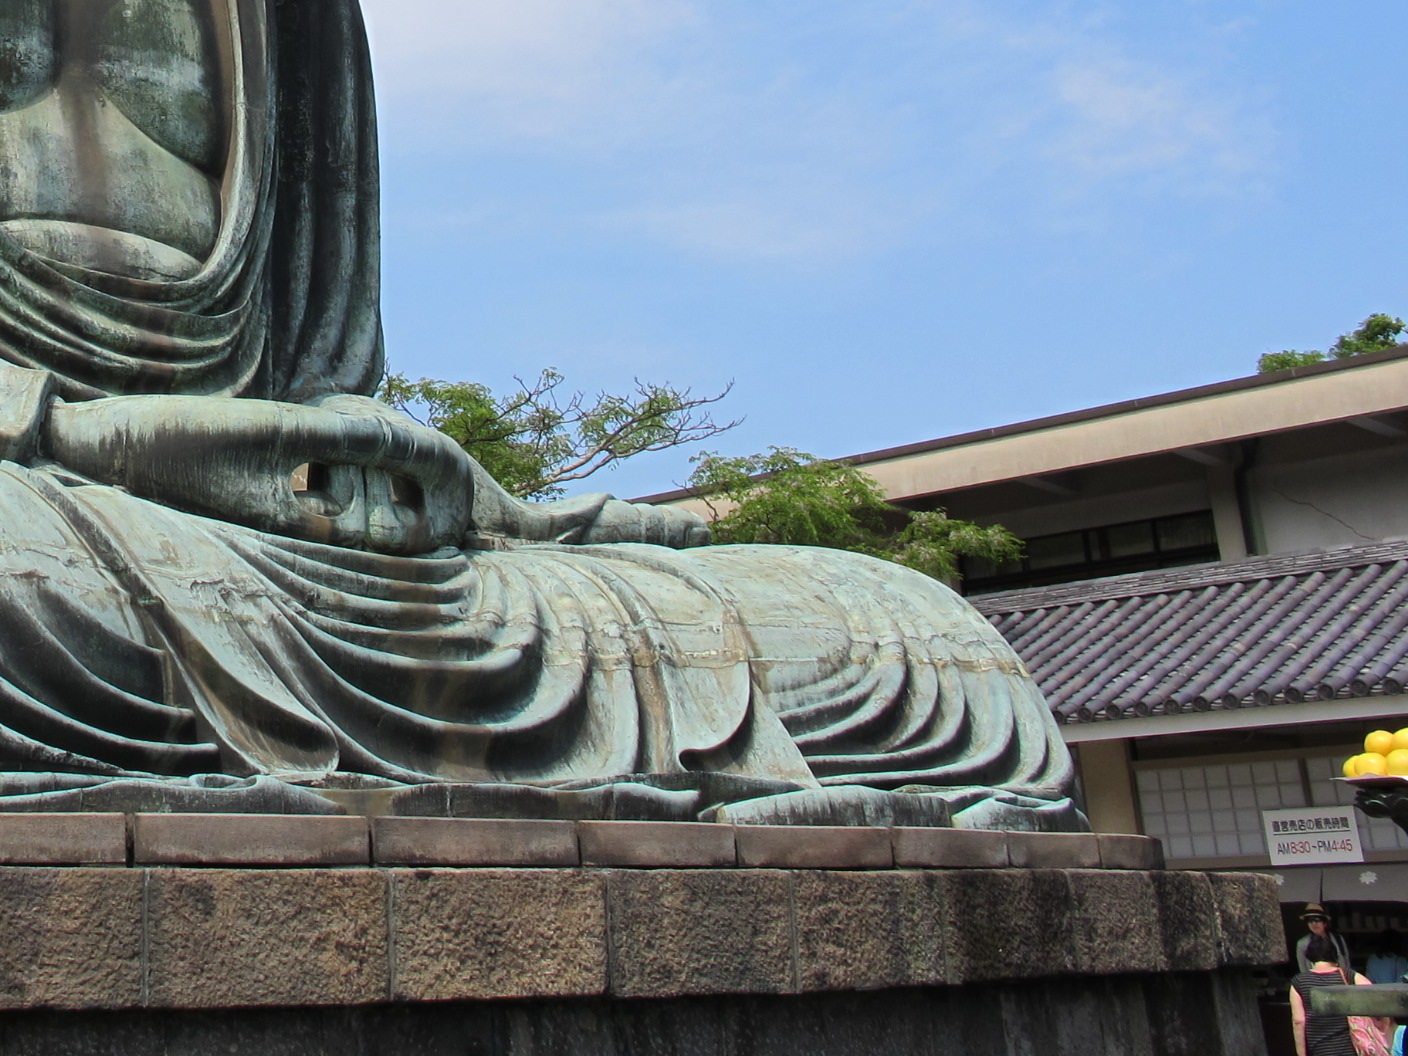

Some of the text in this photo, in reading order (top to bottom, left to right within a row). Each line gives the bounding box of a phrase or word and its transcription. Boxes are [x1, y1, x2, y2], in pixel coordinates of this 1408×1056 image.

[1272, 816, 1350, 833] 直営売店の販売時間
